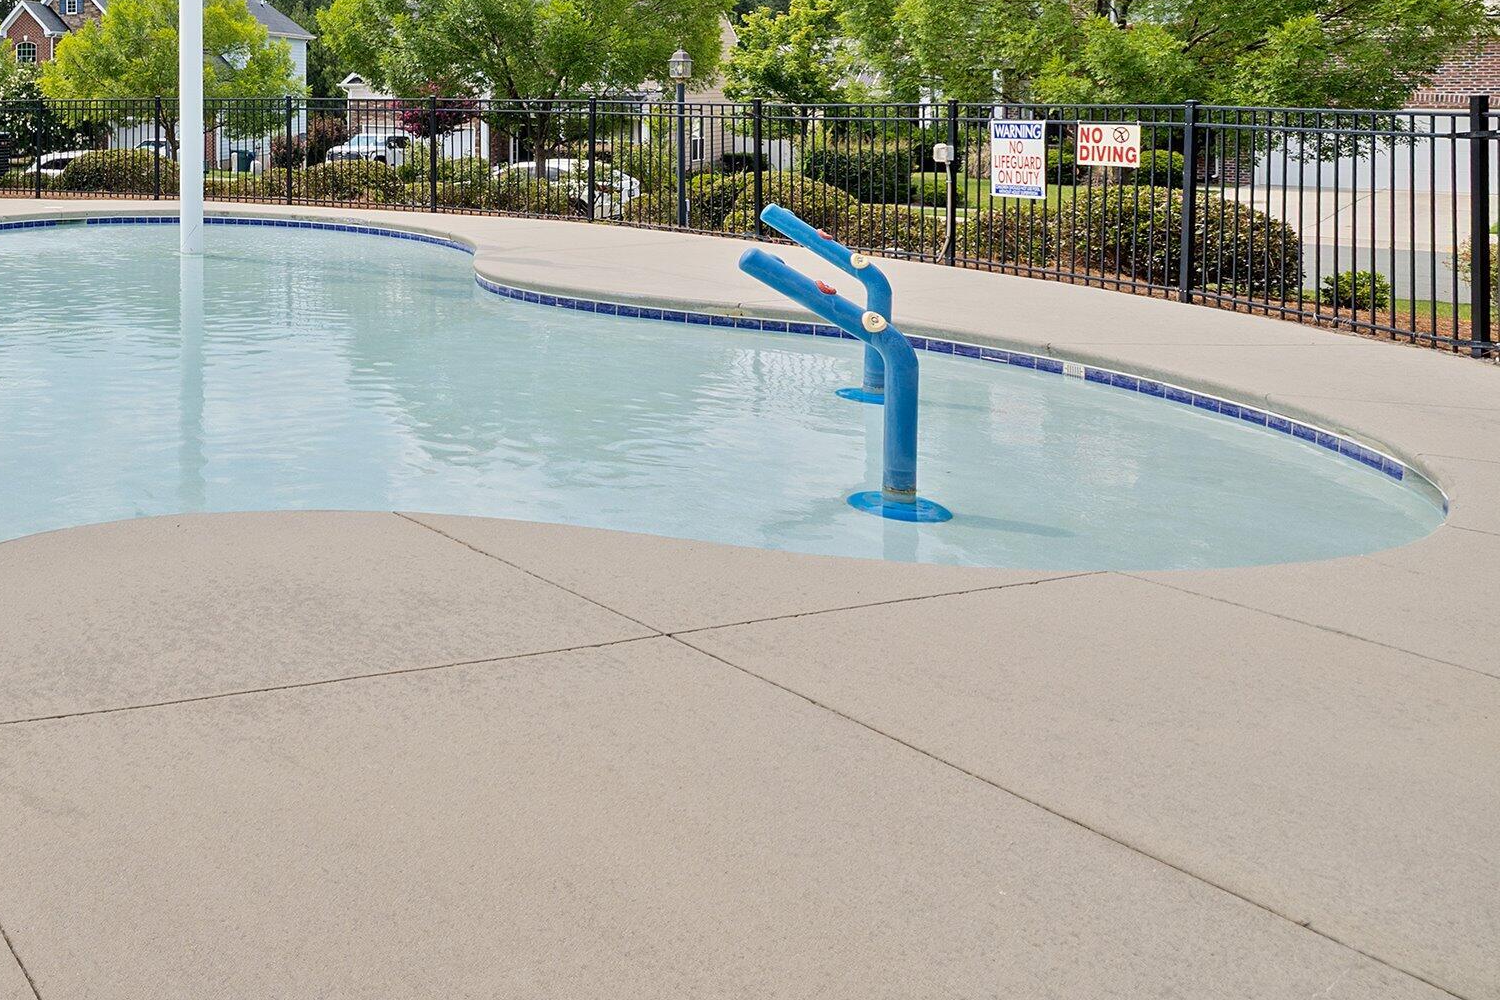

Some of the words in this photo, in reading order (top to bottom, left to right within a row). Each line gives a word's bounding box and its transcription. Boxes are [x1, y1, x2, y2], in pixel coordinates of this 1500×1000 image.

[995, 124, 1042, 139] WARNING
[1080, 127, 1103, 144] NO
[1009, 141, 1024, 154] NO
[1079, 145, 1137, 163] DIVING
[994, 155, 1042, 170] LIFEGUARD
[998, 170, 1013, 184] ON
[1015, 171, 1039, 185] DUTY
